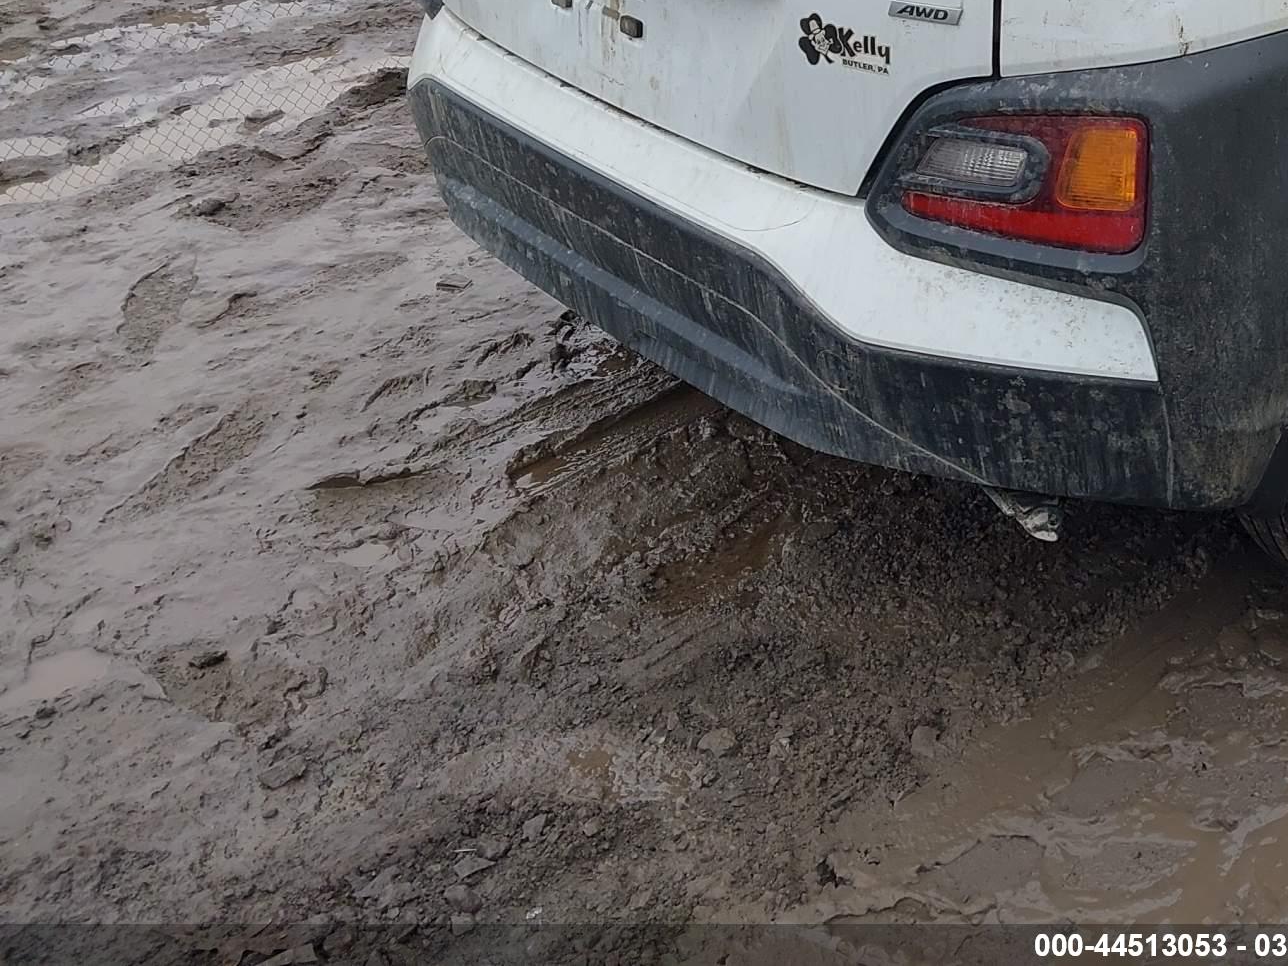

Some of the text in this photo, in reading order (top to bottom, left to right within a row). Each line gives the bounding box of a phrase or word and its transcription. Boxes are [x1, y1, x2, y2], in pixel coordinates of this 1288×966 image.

[897, 4, 948, 21] AWD
[838, 27, 890, 65] Kelly
[842, 58, 889, 75] BUTLER, PA
